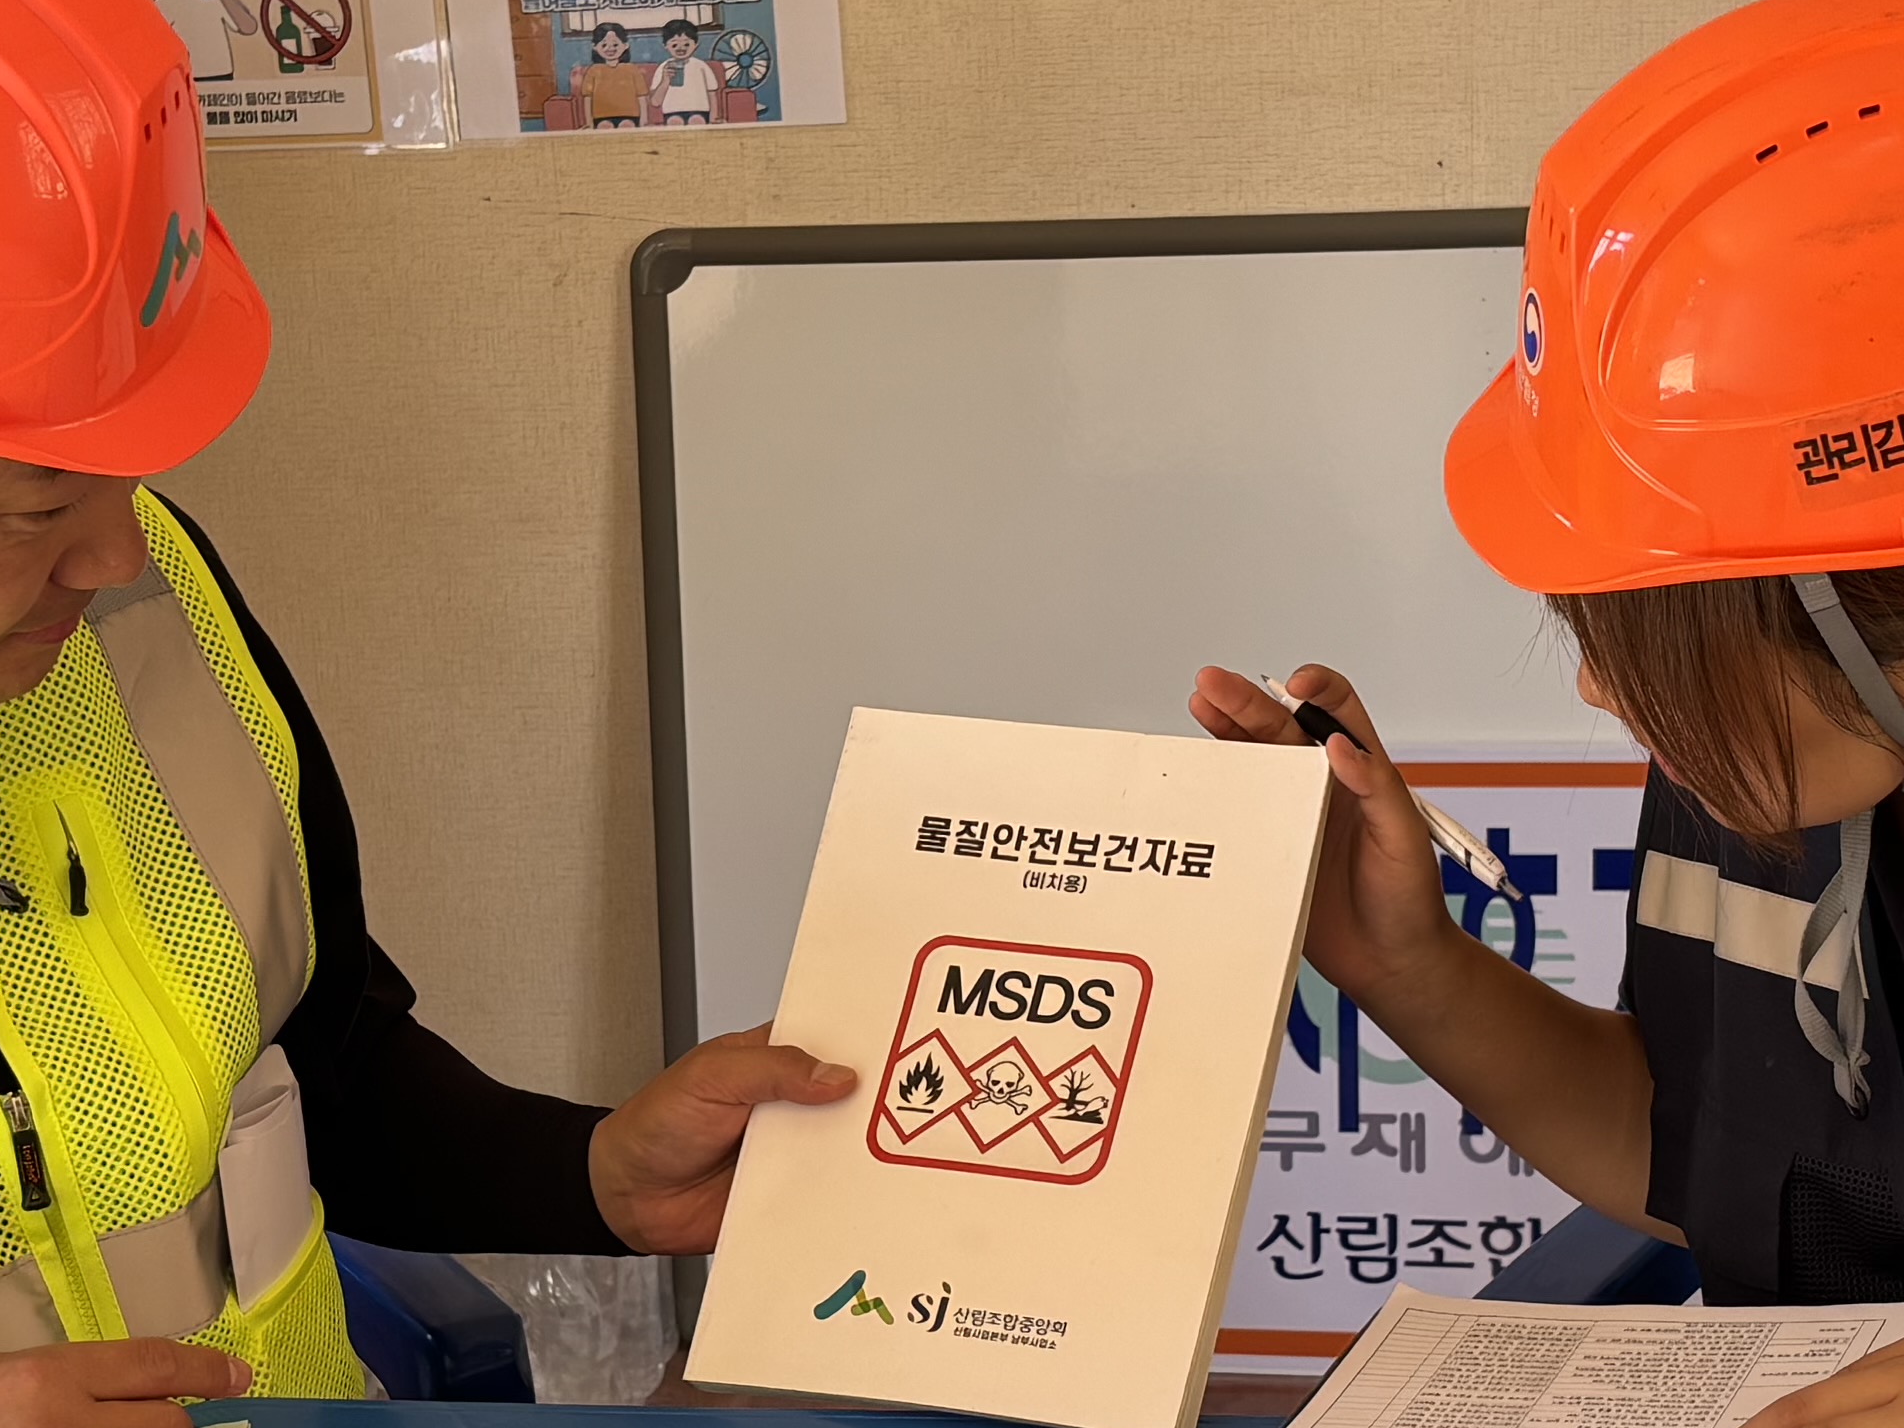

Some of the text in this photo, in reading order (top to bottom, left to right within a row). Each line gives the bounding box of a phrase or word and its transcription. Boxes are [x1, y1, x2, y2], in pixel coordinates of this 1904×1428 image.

[914, 814, 1216, 881] 물질안전보건자료
[1022, 869, 1088, 895] (비치용)
[936, 963, 1115, 1031] MSDS
[953, 1307, 1068, 1338] 산림조합중앙회
